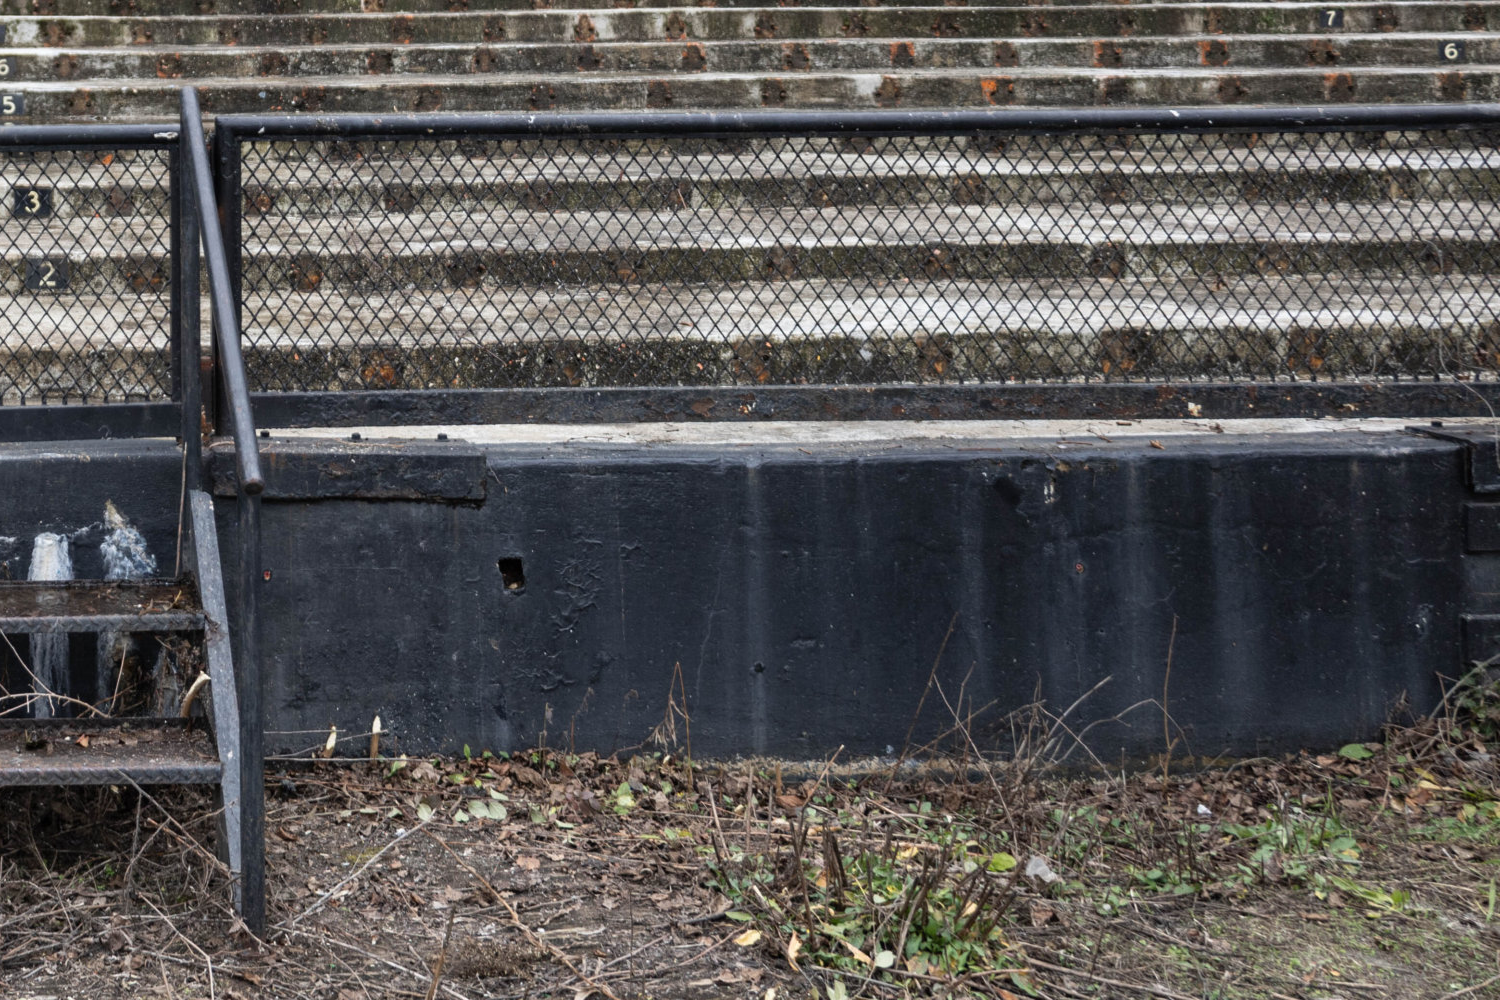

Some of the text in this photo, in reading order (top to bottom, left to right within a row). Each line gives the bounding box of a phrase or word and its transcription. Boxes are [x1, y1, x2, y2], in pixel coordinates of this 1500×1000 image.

[1325, 10, 1337, 26] 7
[1443, 42, 1458, 60] 6
[2, 95, 17, 115] 5
[24, 190, 41, 214] 3
[39, 260, 57, 287] 2
